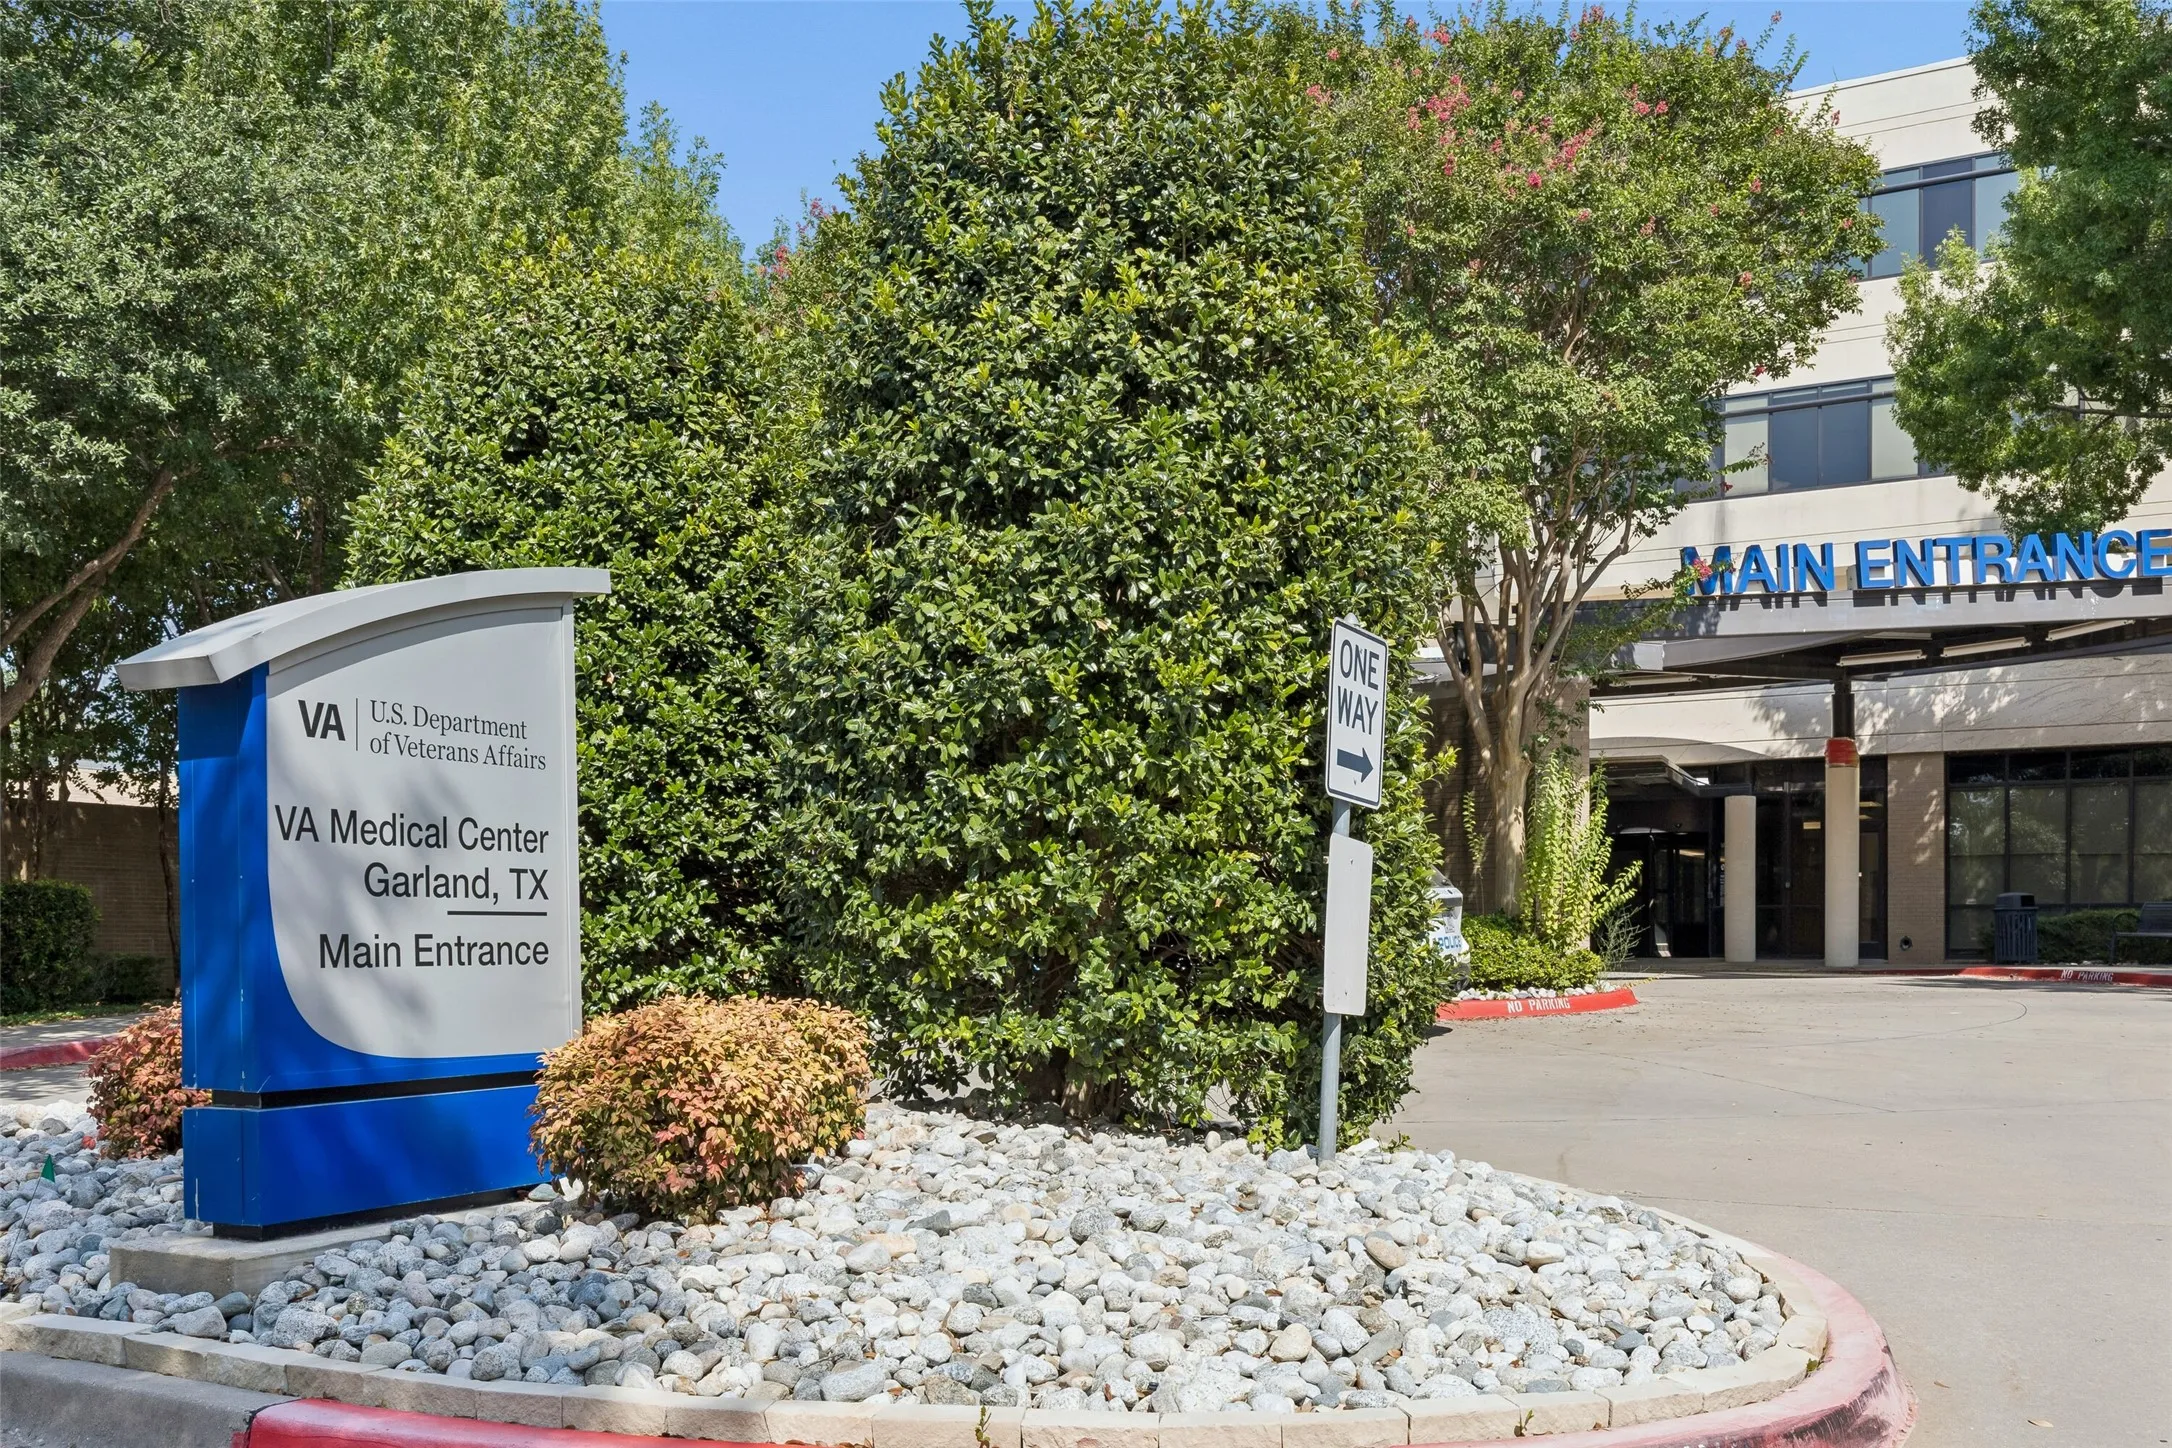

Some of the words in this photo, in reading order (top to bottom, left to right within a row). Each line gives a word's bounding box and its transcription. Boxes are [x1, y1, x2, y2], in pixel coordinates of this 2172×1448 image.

[1680, 542, 1835, 596] MAIN
[1854, 528, 2172, 588] ENTRANCE
[1340, 639, 1380, 691] ONE
[297, 699, 346, 742] VA
[369, 699, 407, 726] U.S.
[412, 705, 528, 740] Department
[1337, 685, 1379, 735] WAY
[369, 731, 393, 755] of
[394, 734, 479, 764] Veterans
[482, 744, 547, 771] Affairs
[274, 804, 320, 842] VA
[330, 808, 448, 849] Medical
[458, 816, 549, 853] Center
[364, 861, 499, 905] Garland,
[509, 867, 549, 901] TX
[319, 933, 402, 969] Main
[414, 933, 549, 968] Entrance
[2061, 969, 2073, 979] NO
[2078, 970, 2114, 982] PARKING
[1506, 1000, 1523, 1014] NO
[1528, 997, 1571, 1012] PARKING
